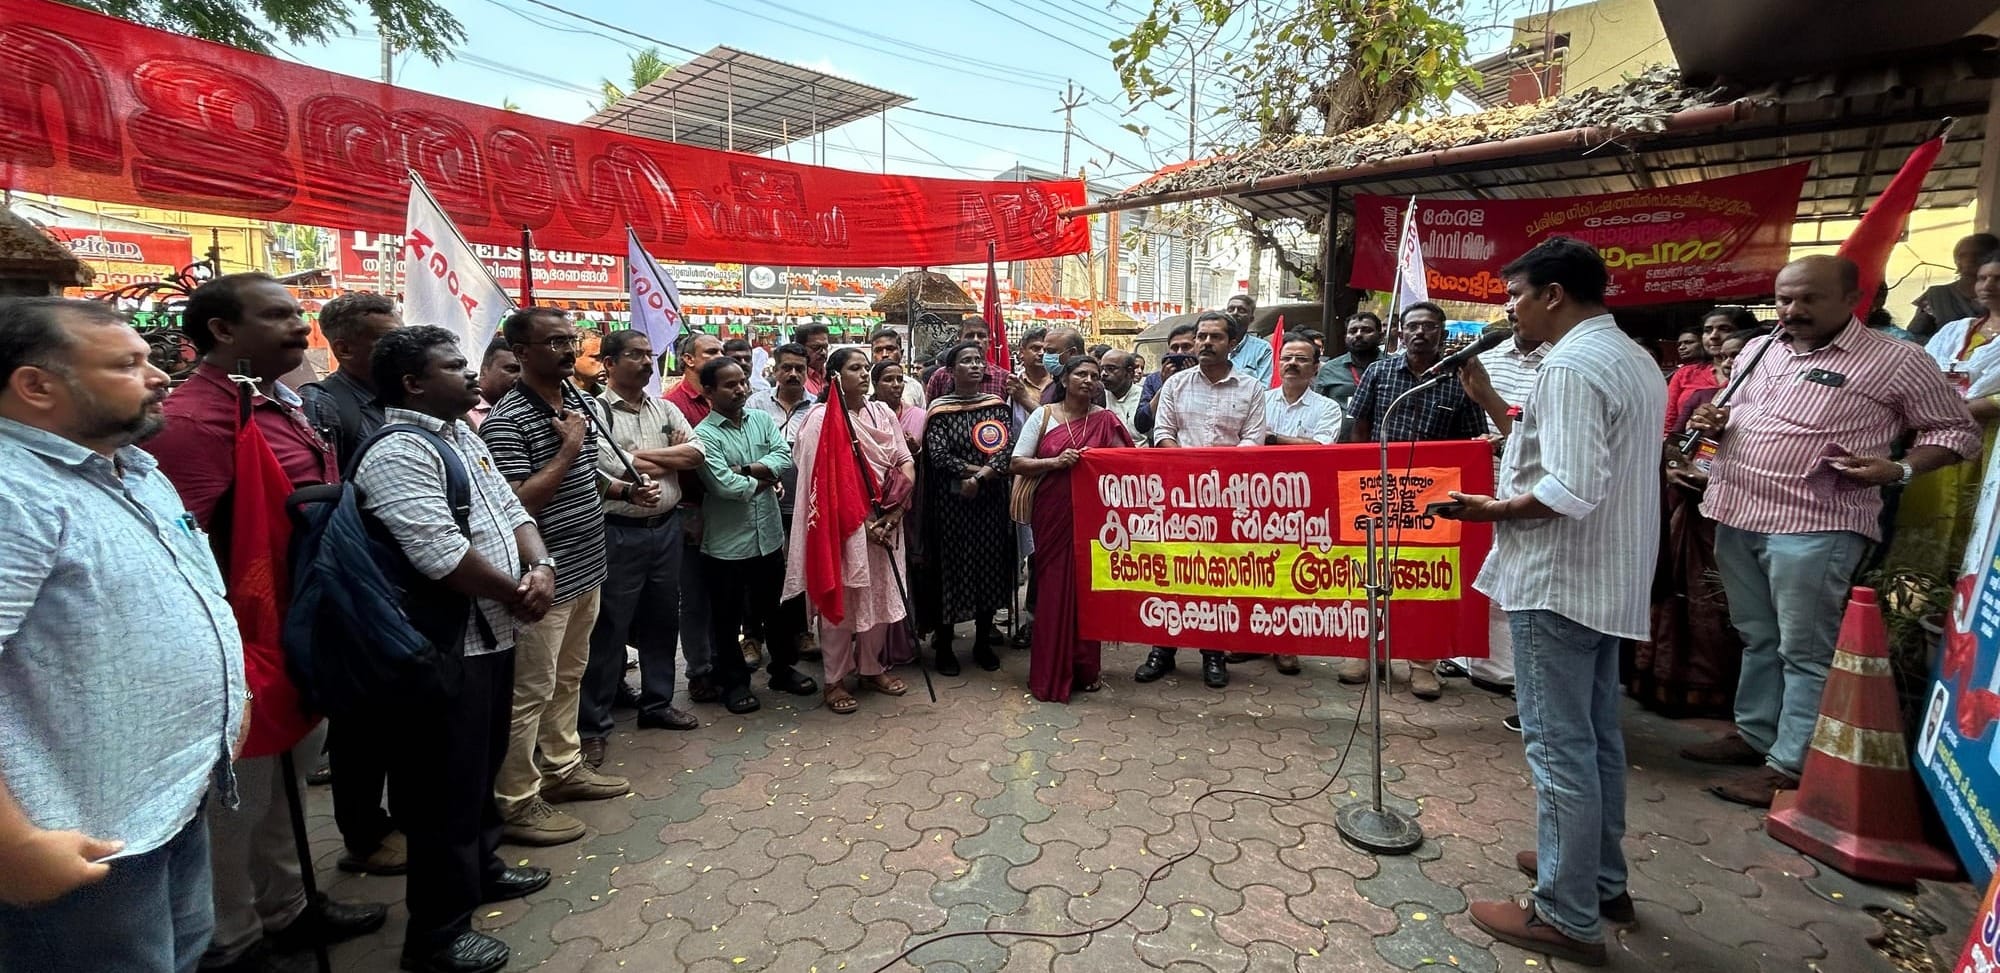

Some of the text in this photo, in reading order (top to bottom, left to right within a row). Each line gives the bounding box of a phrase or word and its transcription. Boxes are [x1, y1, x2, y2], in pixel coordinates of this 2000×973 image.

[1423, 209, 1485, 227] കേരള
[1585, 210, 1686, 228] കേരളം
[548, 250, 617, 267] GIFTS
[1098, 473, 1166, 510] ശമ്പള
[1110, 551, 1170, 587] കേരള
[1140, 596, 1240, 636] ആക്ഷൻ
